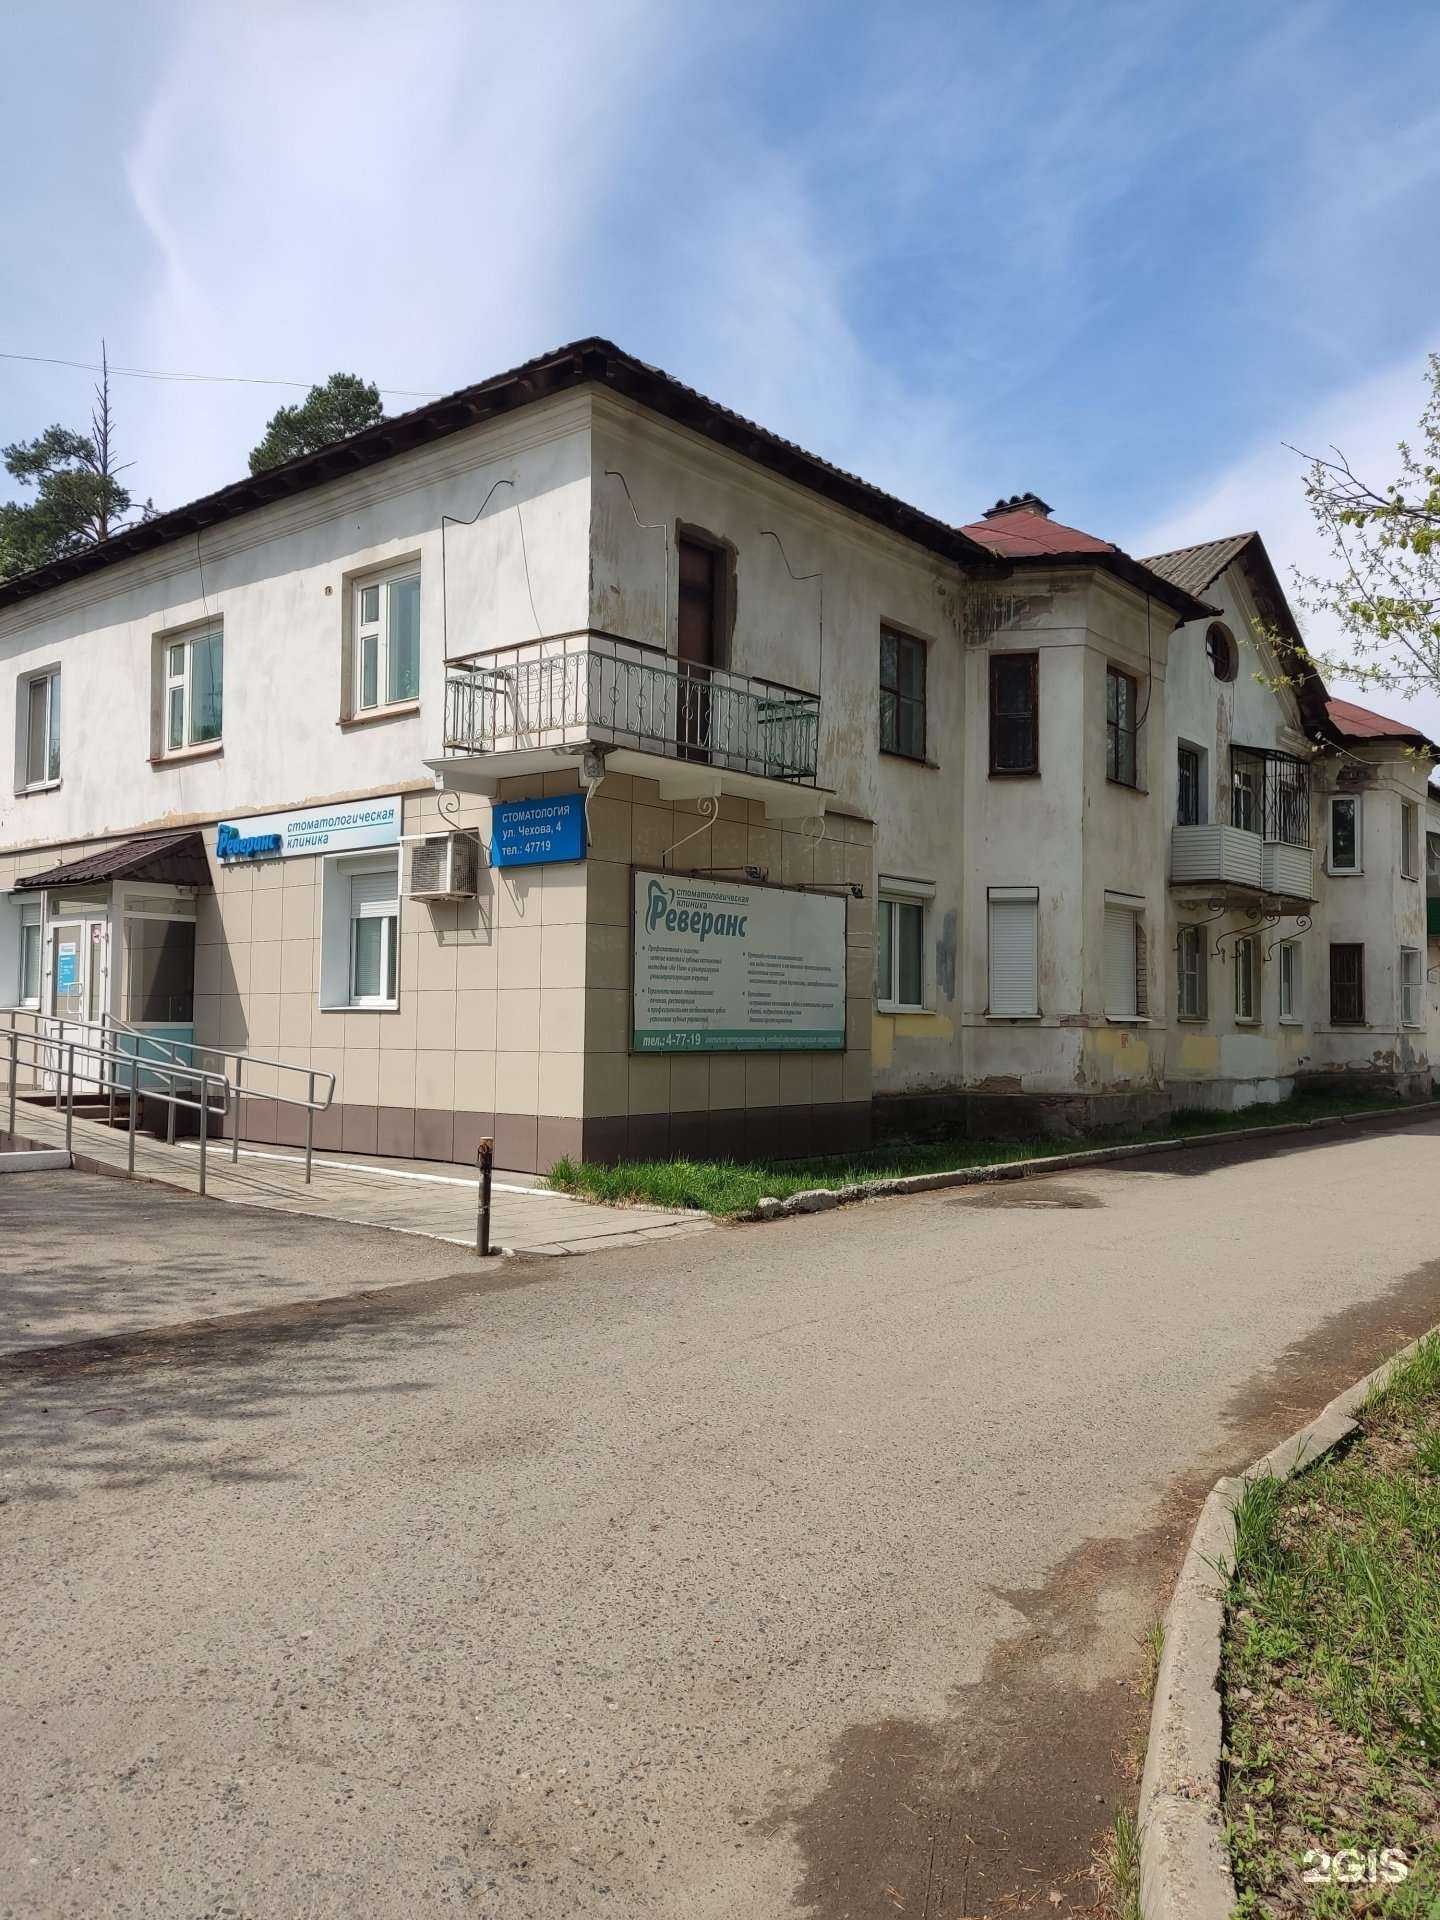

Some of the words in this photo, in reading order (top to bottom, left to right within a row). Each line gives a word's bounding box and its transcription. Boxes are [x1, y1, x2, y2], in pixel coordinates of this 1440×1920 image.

[287, 808, 395, 832] стоматологическая
[502, 805, 570, 823] СТОМАТОЛОГИЯ
[502, 829, 516, 840] ул.
[518, 824, 554, 837] Чехова,
[555, 821, 562, 832] 4
[218, 827, 282, 857] Реверанс
[287, 832, 329, 849] клиника
[501, 845, 523, 856] тел.:
[525, 840, 551, 854] 47719
[676, 888, 750, 904] стоматологическая
[676, 899, 708, 910] клиника
[649, 894, 748, 942] Реверанс
